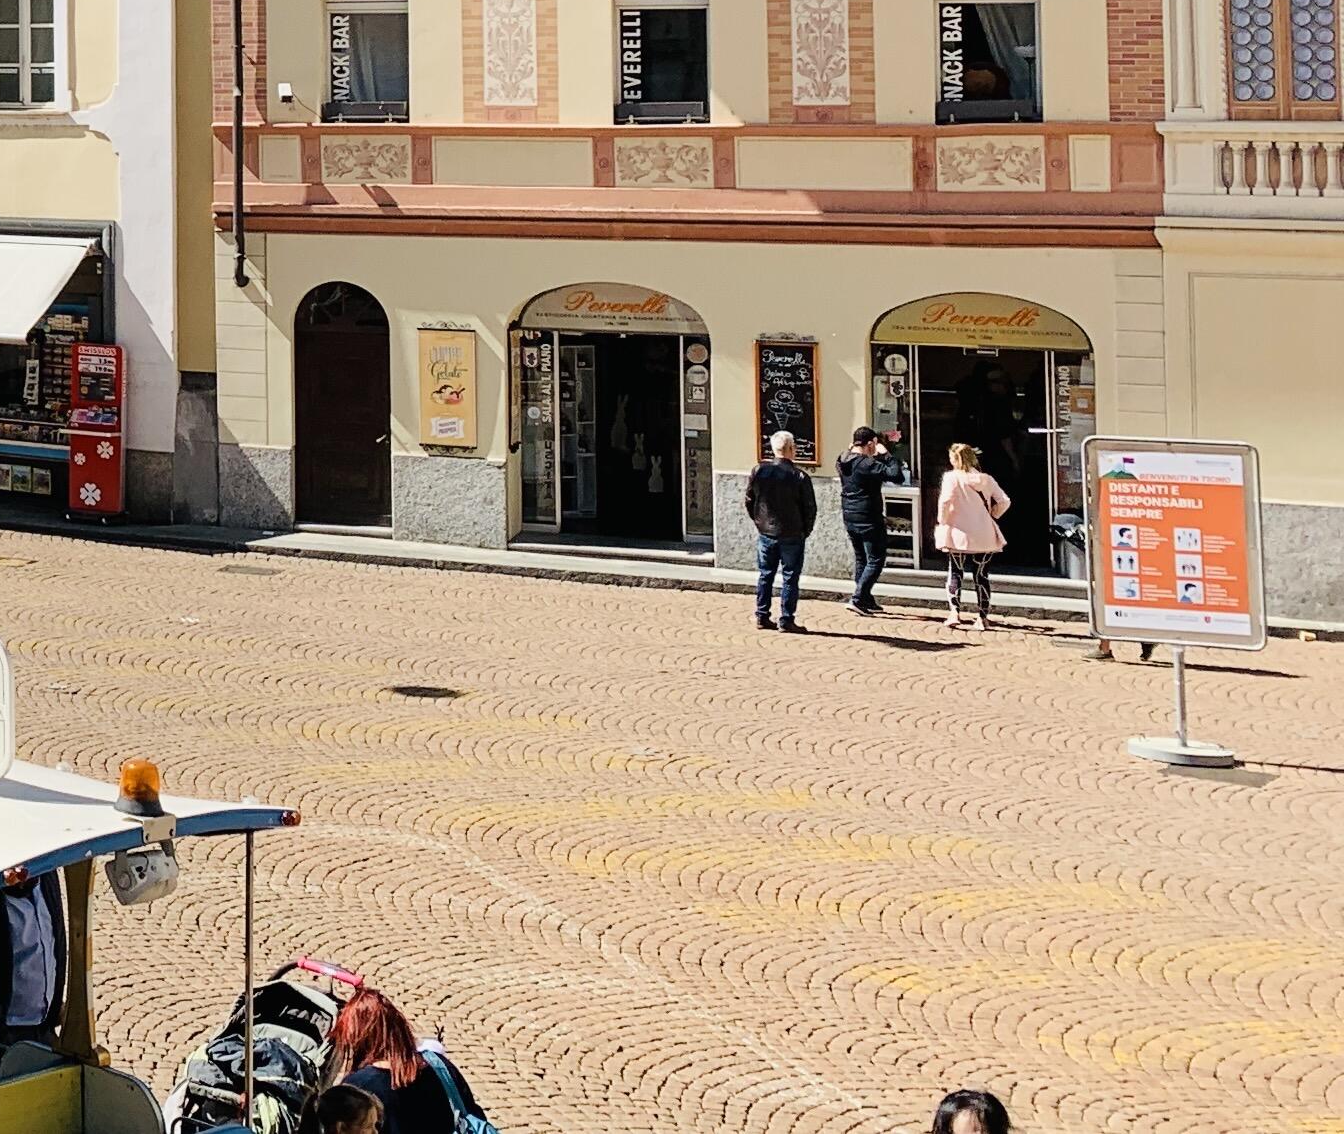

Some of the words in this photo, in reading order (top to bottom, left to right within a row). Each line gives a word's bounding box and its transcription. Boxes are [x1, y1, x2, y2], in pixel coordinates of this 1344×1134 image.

[332, 15, 350, 49] BAR
[942, 6, 962, 42] BAR
[622, 11, 642, 104] EVERELLI
[333, 55, 350, 103] NACK
[943, 49, 963, 102] NACK
[565, 290, 669, 314] Peverelli
[922, 302, 1040, 327] Peverelli
[540, 343, 551, 371] PIANO
[542, 398, 552, 423] SALA
[1109, 482, 1168, 495] DISTANTI
[1171, 485, 1179, 495] E
[1139, 473, 1188, 482] BENVENUTI
[1109, 494, 1203, 509] RESPONSABILI
[1110, 507, 1163, 519] SEMPRE
